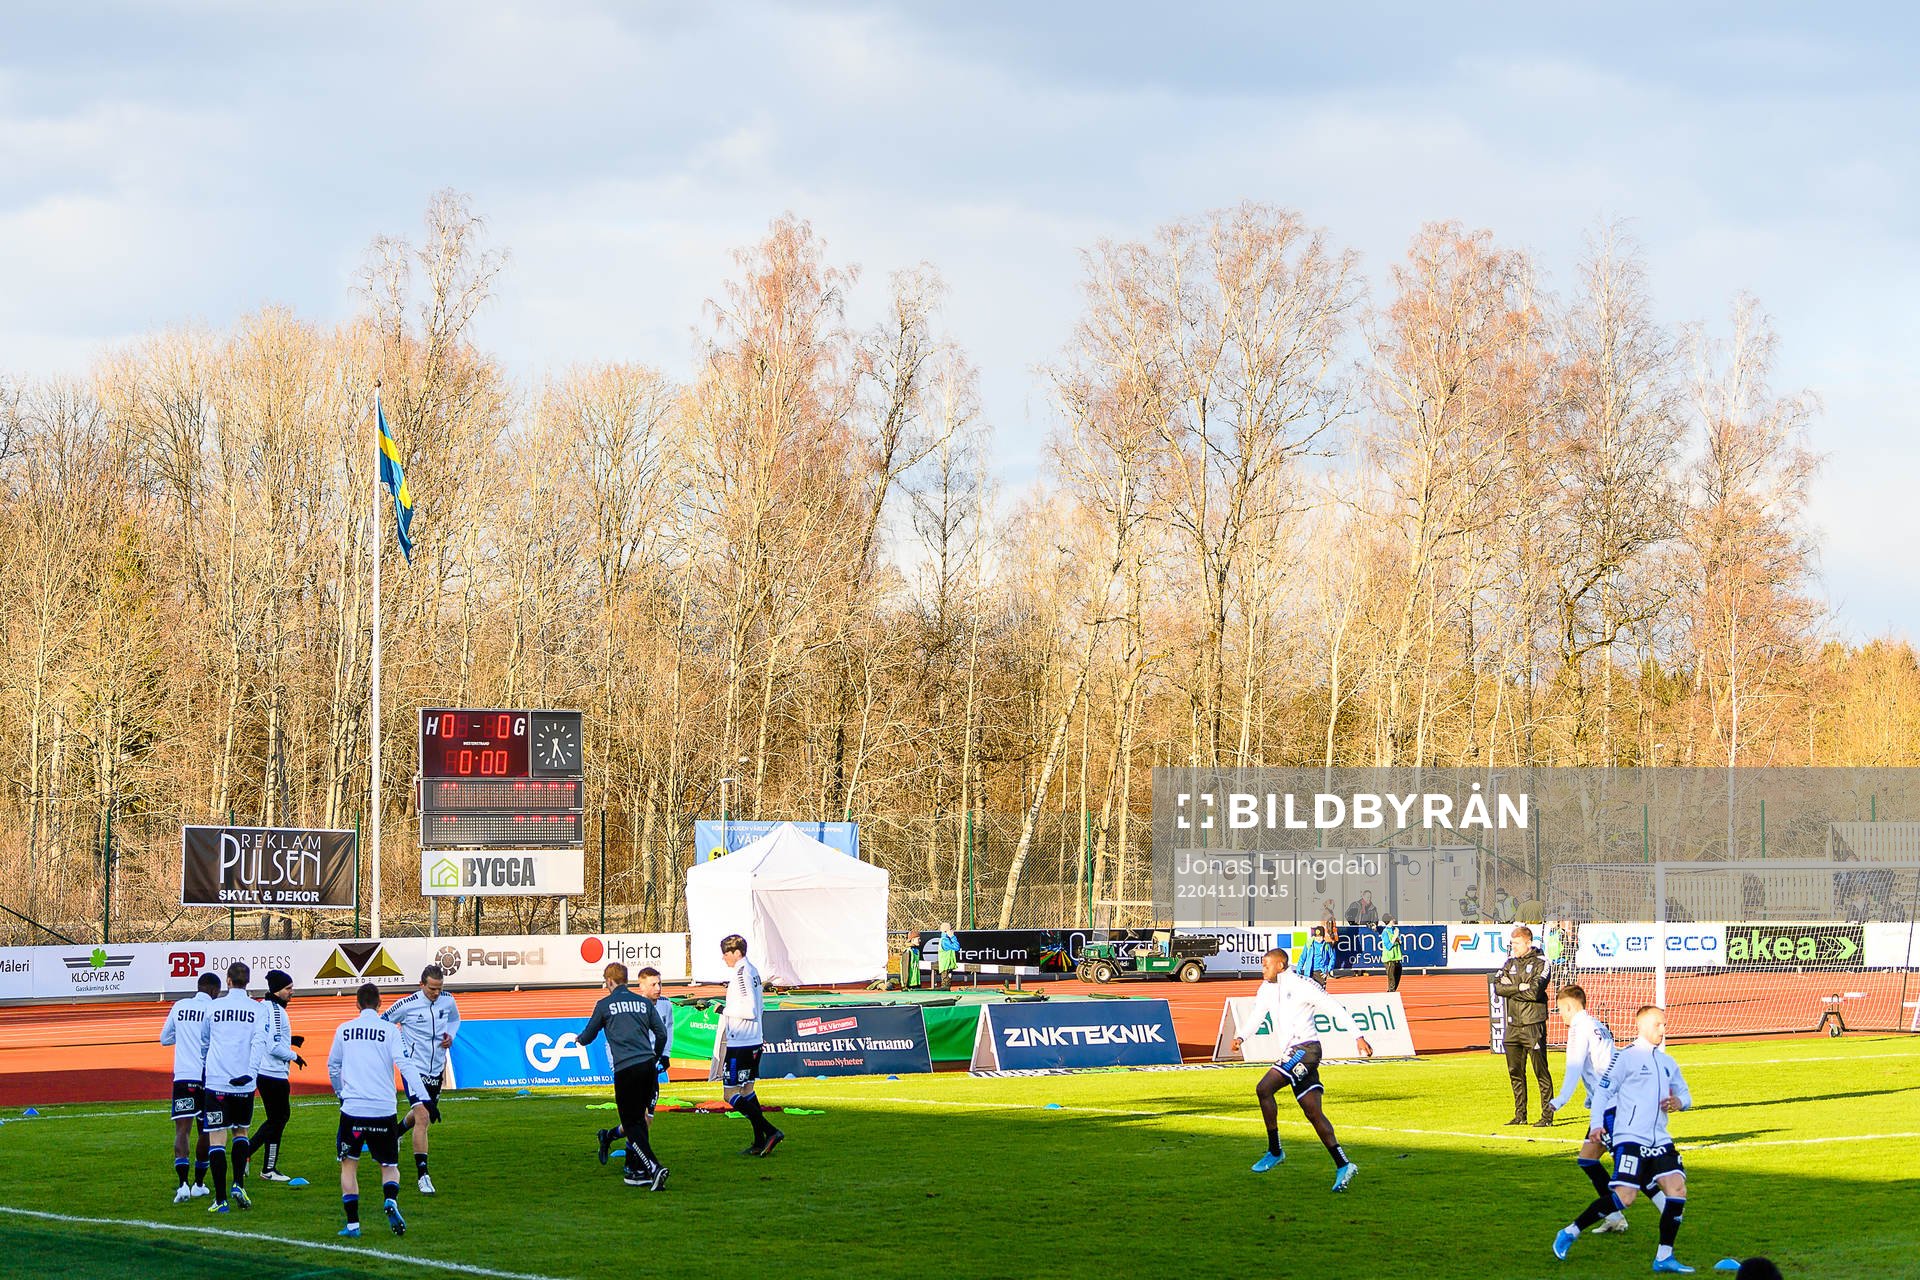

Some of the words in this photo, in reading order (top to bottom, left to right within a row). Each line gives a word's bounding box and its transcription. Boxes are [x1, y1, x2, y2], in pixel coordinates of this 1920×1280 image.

[426, 717, 439, 735] H
[514, 718, 526, 736] G
[242, 834, 321, 849] REKLAM
[219, 833, 321, 886] PULSEN
[463, 857, 536, 887] BYGGA
[219, 890, 259, 901] SKYLT
[263, 890, 272, 901] &
[276, 890, 320, 902] DEKOR
[607, 940, 661, 964] Hjerta
[1728, 930, 1816, 960] akea
[252, 956, 291, 969] PRESS
[467, 947, 545, 969] Rapid
[71, 970, 110, 983] KLÖFVER
[111, 971, 125, 981] AB
[214, 1010, 255, 1023] SIRIUS
[609, 1001, 647, 1015] SIRIUS
[343, 1028, 386, 1042] SIRIUS
[1003, 1024, 1166, 1047] ZINKTEKNIK
[777, 1038, 831, 1053] närmare
[832, 1038, 857, 1051] IFK
[857, 1036, 914, 1050] Värnamo
